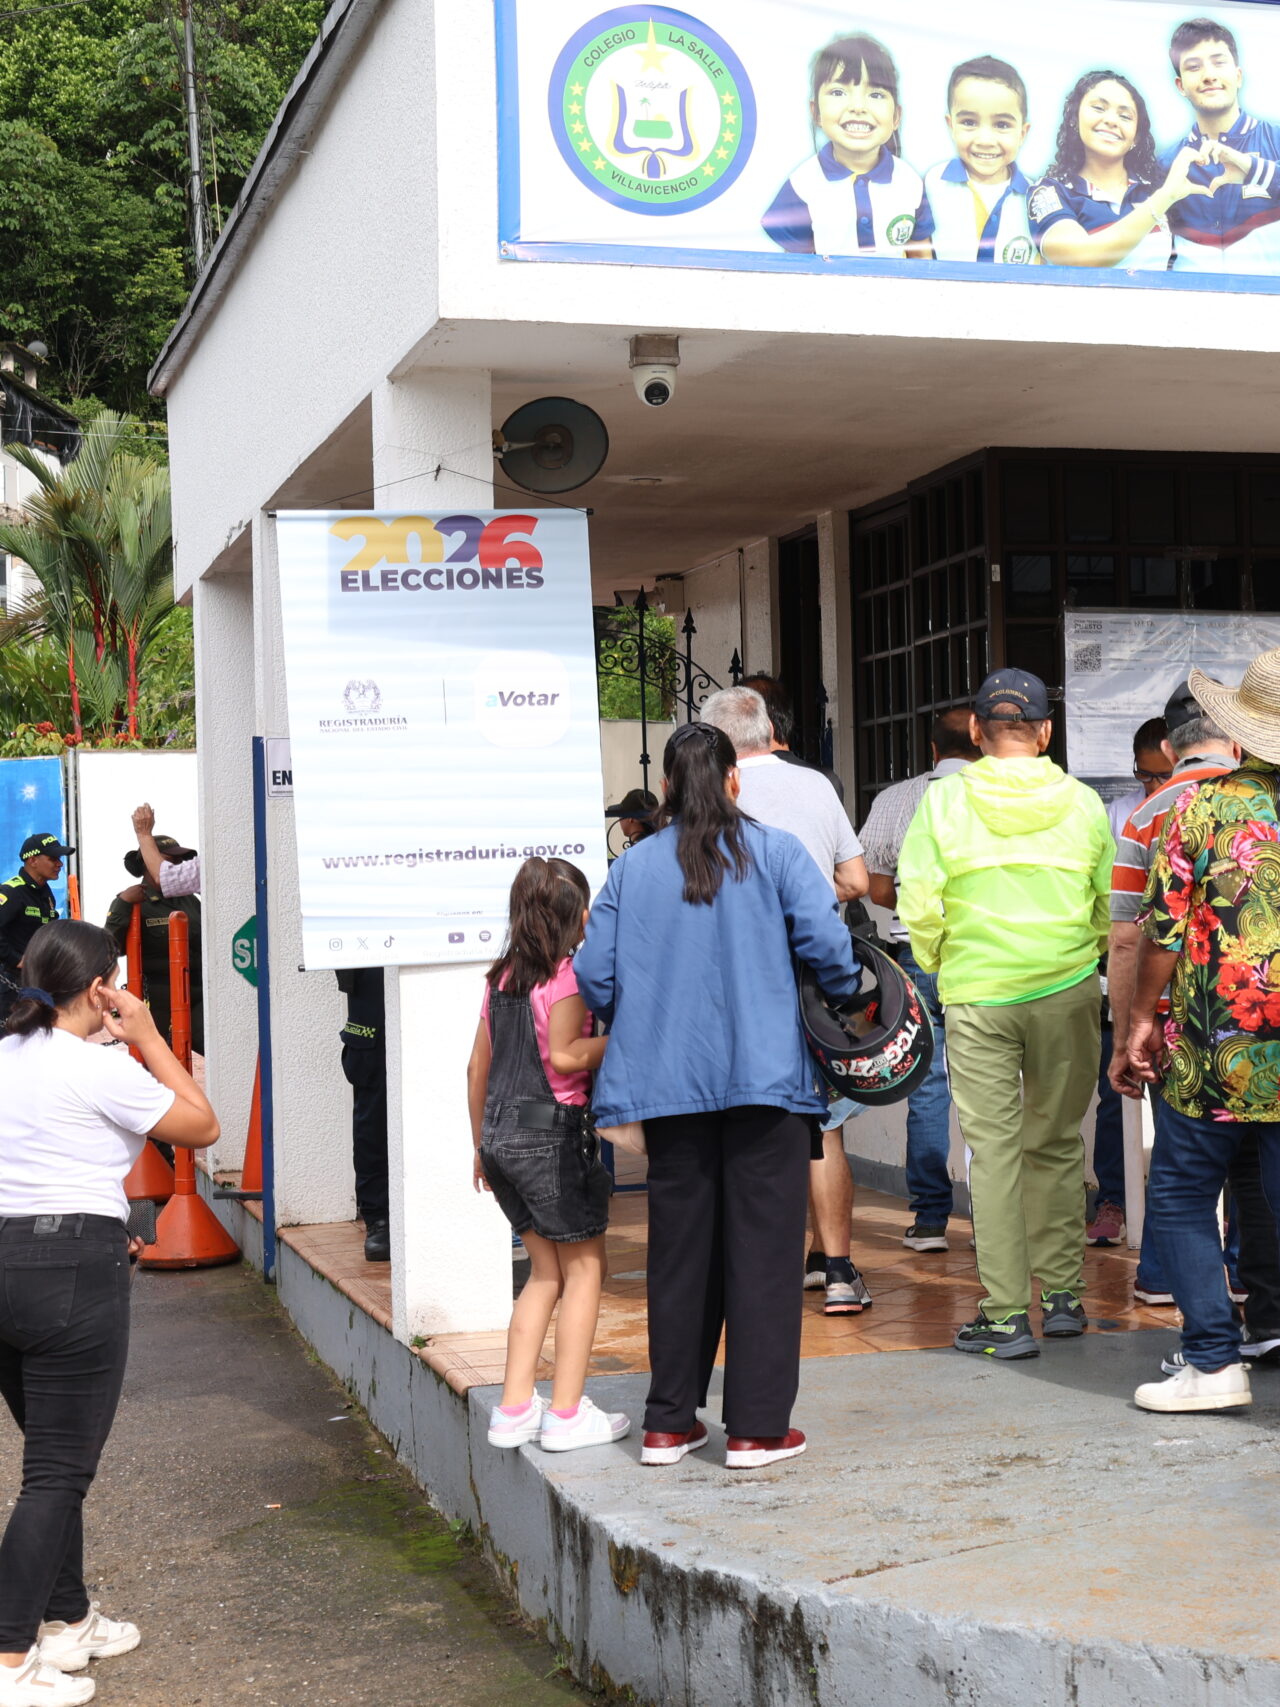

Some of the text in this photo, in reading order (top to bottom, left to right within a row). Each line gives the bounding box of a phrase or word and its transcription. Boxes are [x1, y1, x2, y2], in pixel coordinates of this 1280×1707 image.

[583, 28, 724, 79] COLEGIO LA SALLE
[610, 170, 698, 195] VILLAVICENCIO
[328, 514, 544, 571] 2026
[341, 567, 544, 592] ELECCIONES
[485, 690, 560, 709] aVotar
[322, 842, 585, 869] www.registraduria.gov.co
